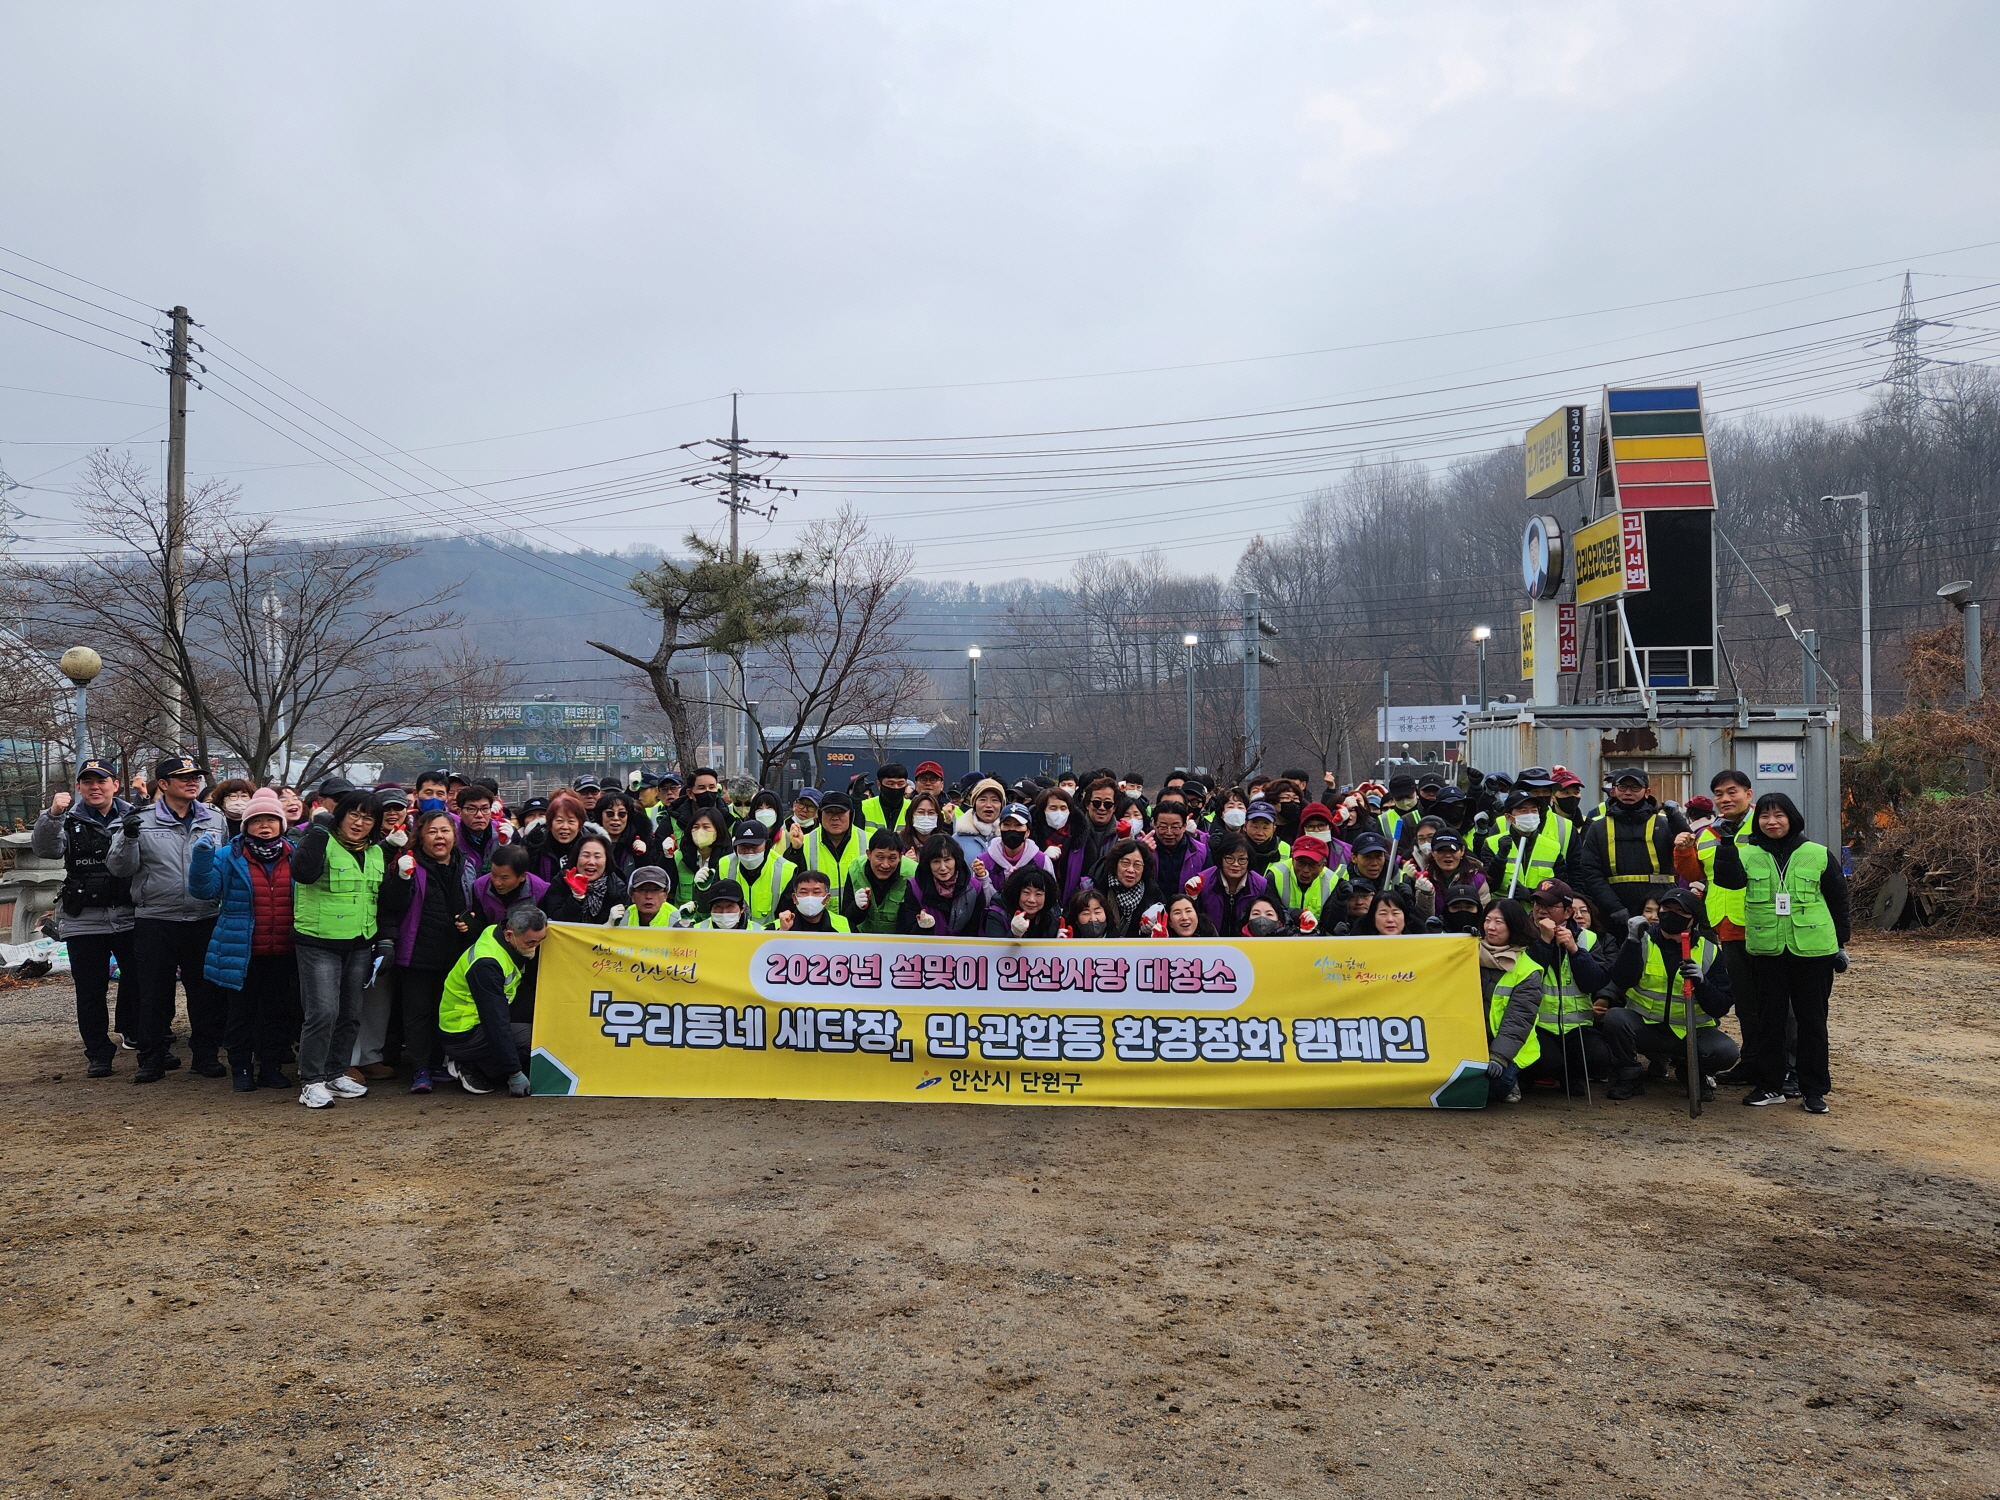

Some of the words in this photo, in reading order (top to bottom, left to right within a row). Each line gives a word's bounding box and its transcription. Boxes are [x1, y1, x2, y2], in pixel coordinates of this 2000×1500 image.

[1571, 409, 1581, 473] 319-7730
[1576, 533, 1622, 586] 오리요리전문점
[1624, 515, 1646, 584] 고기서봐
[1559, 607, 1577, 668] 고기서봐
[1398, 724, 1437, 733] 짬뽕순두부
[827, 753, 855, 761] seaco
[1760, 764, 1793, 772] SECOM
[765, 952, 883, 989] 2026년
[890, 953, 988, 991] 설맞이
[996, 957, 1129, 993] 안산사랑
[1136, 958, 1238, 994] 대청소
[1391, 971, 1418, 983] 안산
[925, 1012, 1105, 1062] 민·관합동
[1112, 1014, 1287, 1062] 환경정화
[1292, 1015, 1430, 1063] 캠페인
[949, 1069, 1012, 1093] 안산시
[1020, 1071, 1084, 1095] 단원구
